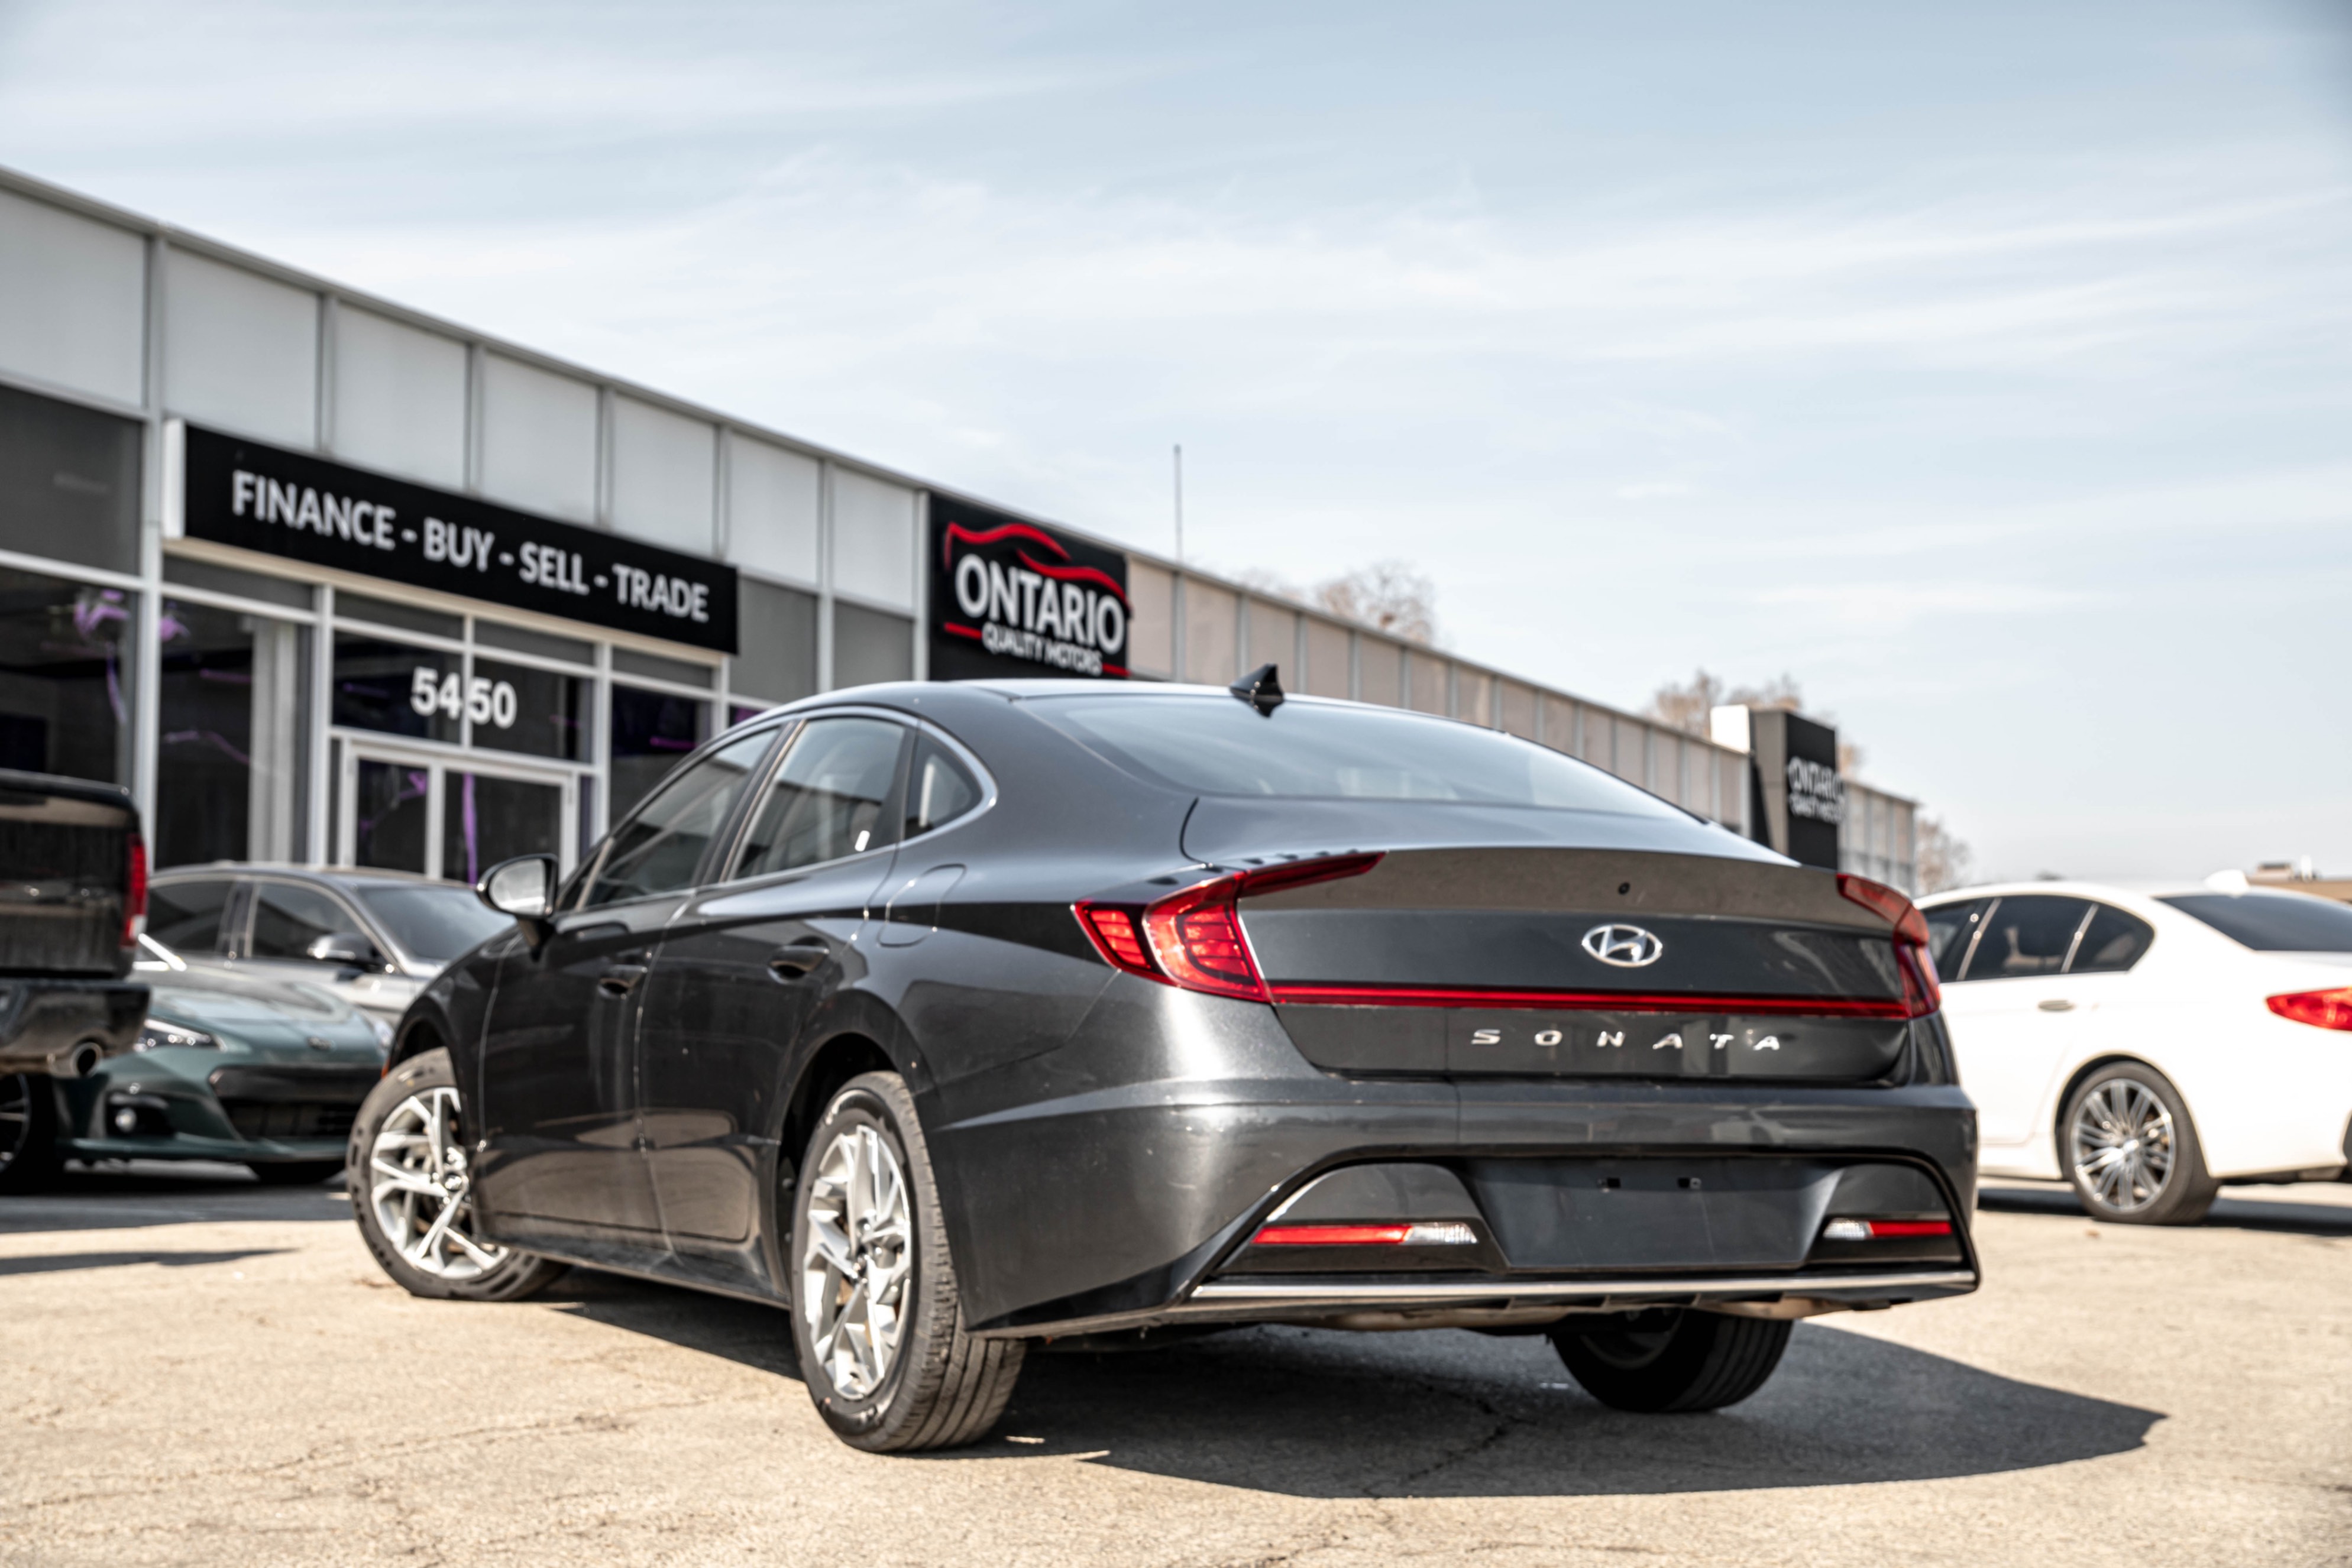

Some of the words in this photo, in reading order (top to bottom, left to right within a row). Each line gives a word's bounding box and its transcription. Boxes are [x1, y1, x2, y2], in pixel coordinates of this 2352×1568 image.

[232, 470, 396, 550] FINANCE
[423, 517, 494, 571] BUY
[519, 541, 589, 595] SELL
[612, 563, 708, 622] TRADE
[955, 553, 1124, 654] ONTARIO
[982, 622, 1044, 662] QUALITY
[1043, 639, 1102, 675] MOTORS
[410, 666, 517, 728] 5450
[1471, 1029, 1781, 1051] SONATA
